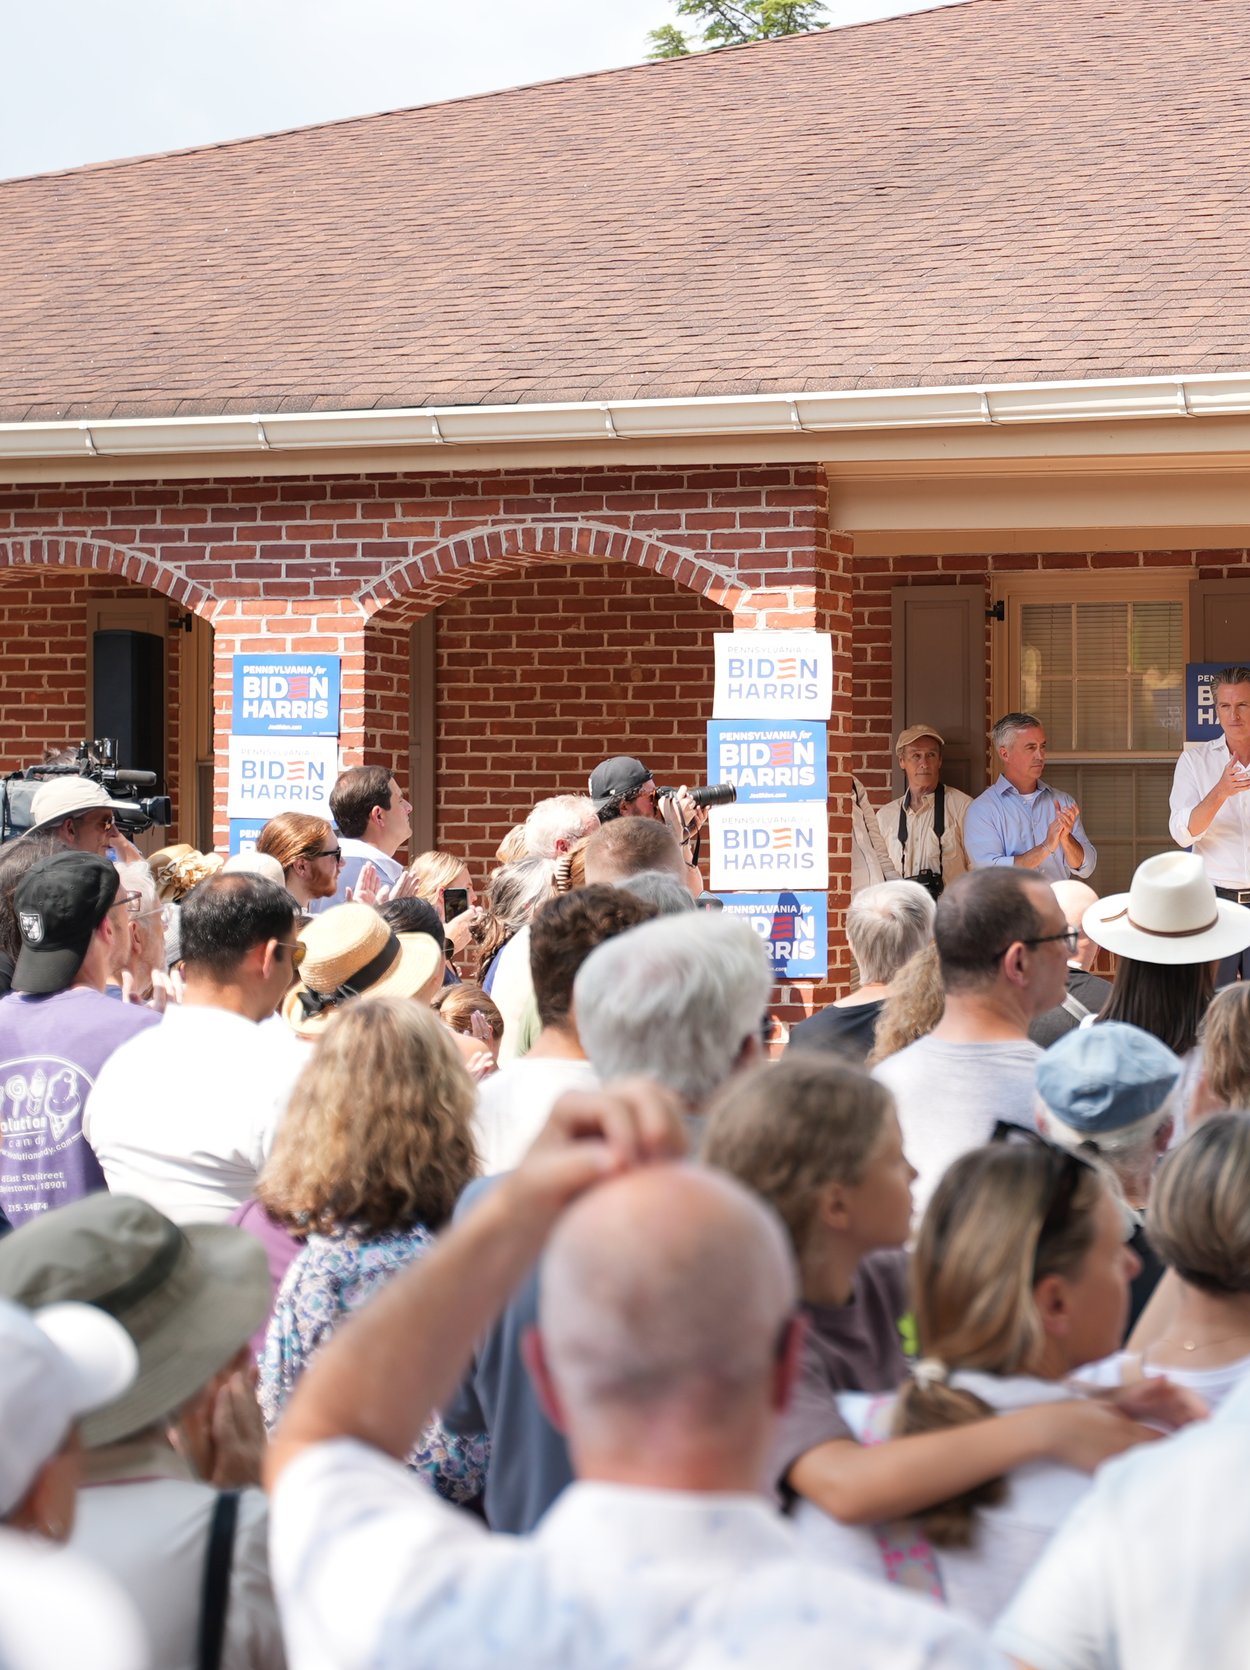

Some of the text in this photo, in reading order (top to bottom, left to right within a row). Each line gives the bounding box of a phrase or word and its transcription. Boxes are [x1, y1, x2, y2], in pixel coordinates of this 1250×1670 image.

[242, 665, 328, 676] PENNSYLVANIA for
[728, 658, 818, 680] BIDEN
[242, 676, 329, 700] BIDEN
[728, 683, 818, 700] HARRIS
[242, 700, 329, 720] HARRIS
[719, 730, 812, 742] PENNSYLVANIA for
[719, 742, 815, 766] BIDEN
[241, 760, 325, 781] BIDEN
[719, 766, 816, 787] HARRIS
[240, 784, 325, 801] HARRIS
[722, 827, 814, 850] BIDEN
[724, 852, 815, 870] HARRIS
[722, 903, 813, 914] PENNSYLVANIA for
